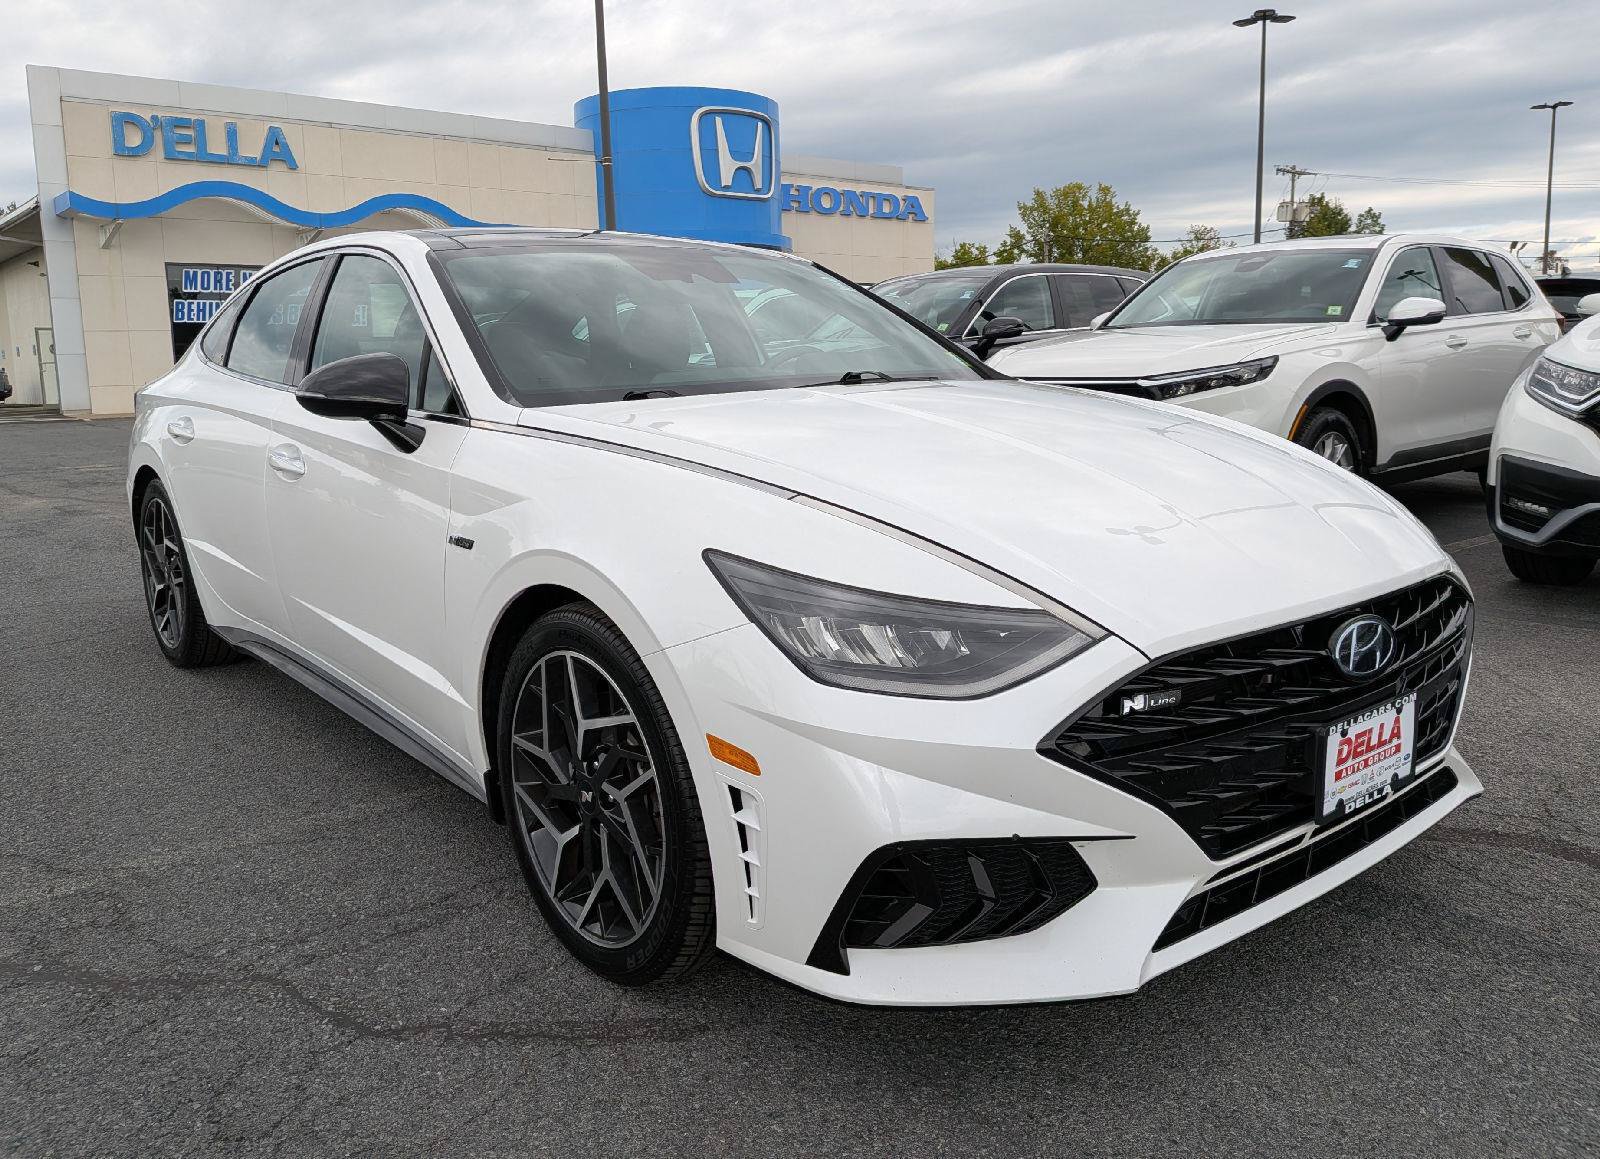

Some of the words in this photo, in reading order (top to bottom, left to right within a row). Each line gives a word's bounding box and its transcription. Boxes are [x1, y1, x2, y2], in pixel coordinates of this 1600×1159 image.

[110, 110, 299, 170] D'ELLA
[781, 183, 929, 222] HONDA
[183, 269, 235, 292] MORE
[1329, 692, 1417, 736] DELLACARS.COM
[1336, 715, 1401, 768] DELLA
[1341, 760, 1365, 778] AUTO
[1368, 746, 1396, 765] GROUP
[1345, 785, 1393, 814] DELLA
